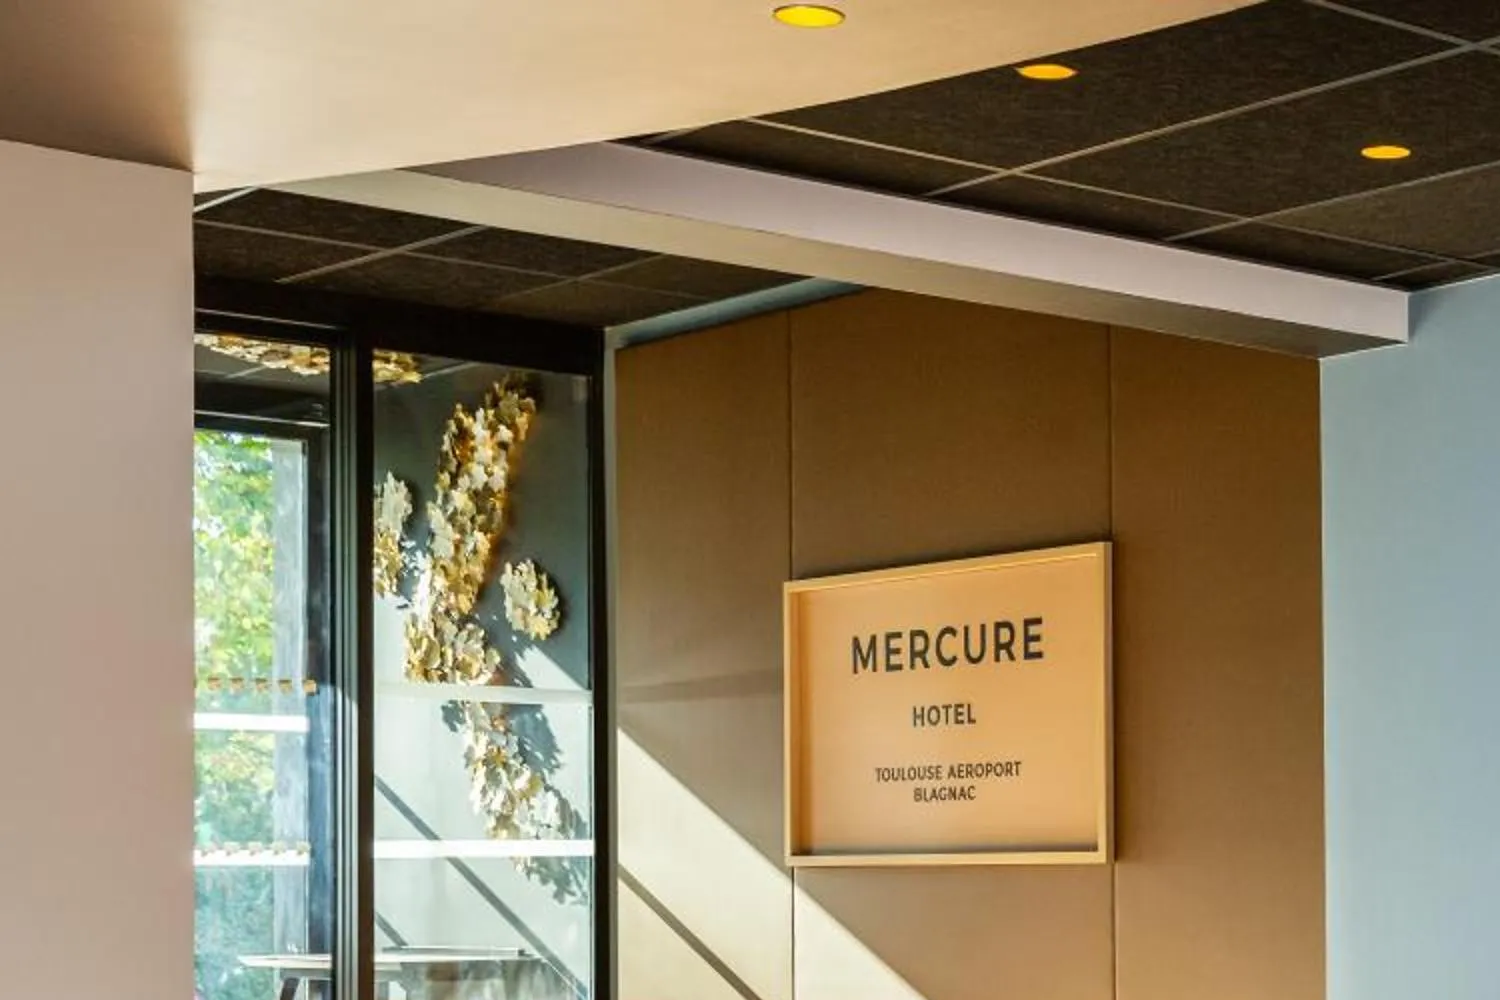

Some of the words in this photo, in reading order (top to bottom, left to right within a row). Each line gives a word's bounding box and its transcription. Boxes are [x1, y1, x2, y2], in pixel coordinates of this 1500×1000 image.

[852, 616, 1044, 675] MERCURE
[912, 702, 977, 727] HOTEL
[875, 764, 943, 782] TOULOUSE
[947, 760, 1022, 779] AEROPORT
[913, 785, 976, 803] BLAGNAC
